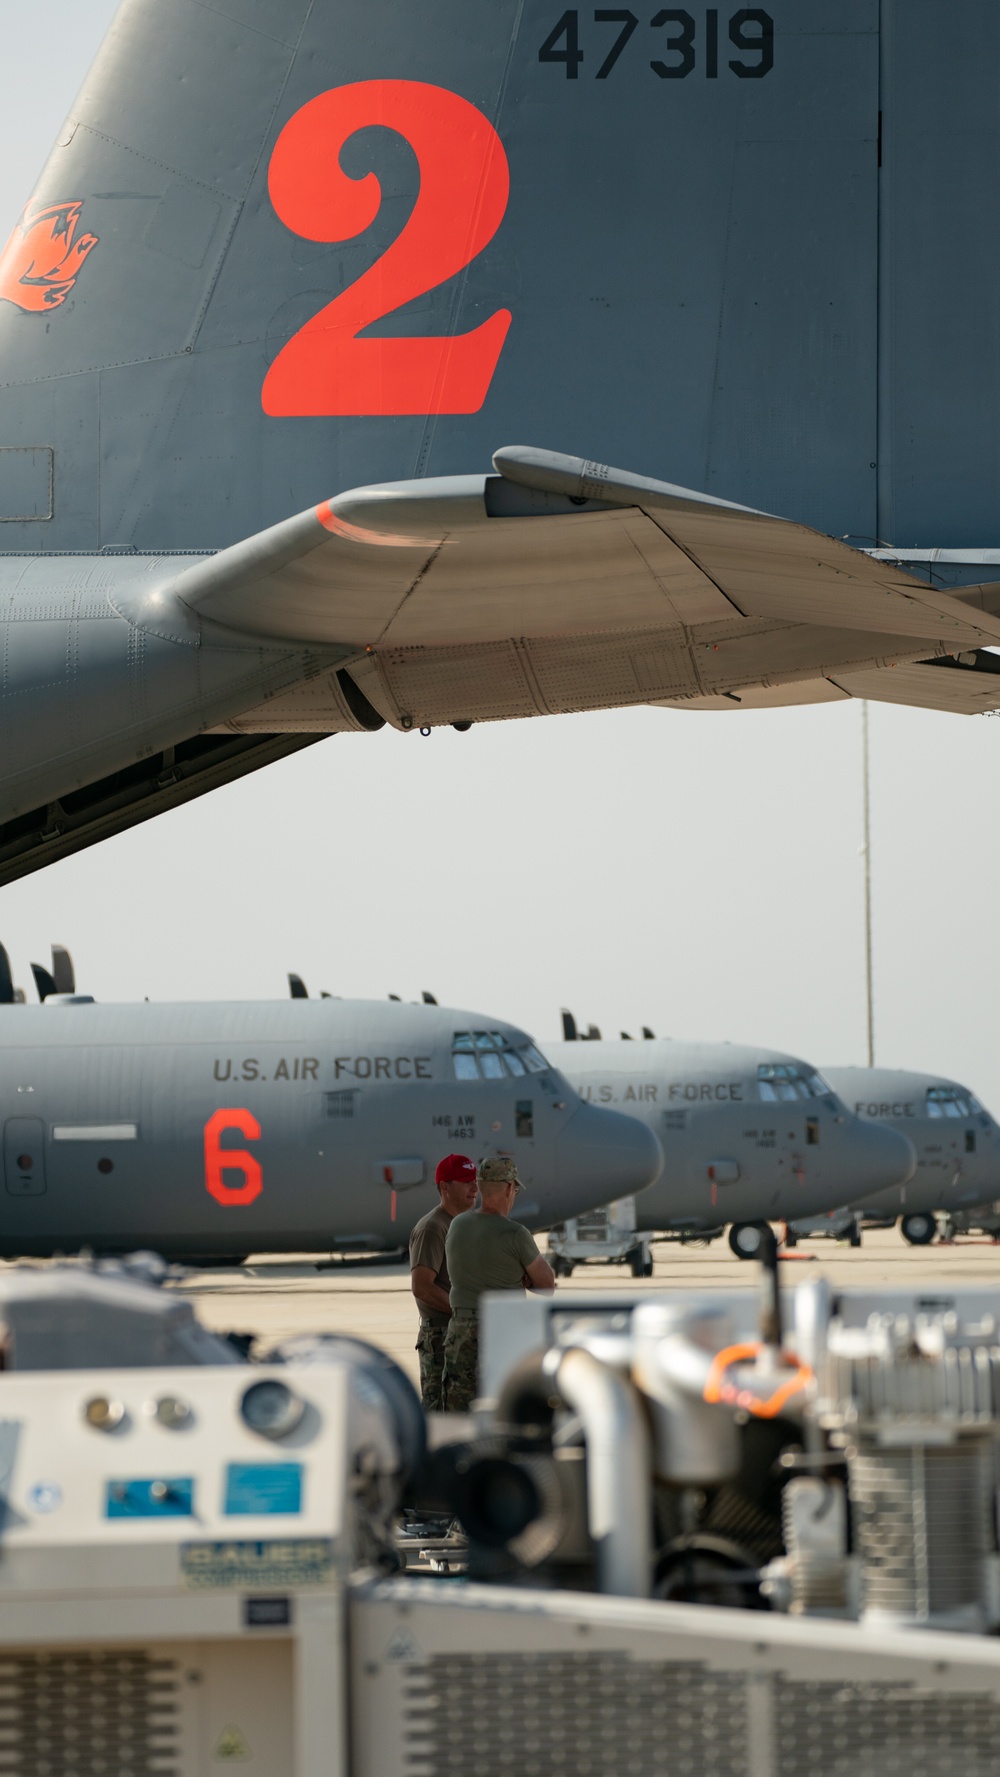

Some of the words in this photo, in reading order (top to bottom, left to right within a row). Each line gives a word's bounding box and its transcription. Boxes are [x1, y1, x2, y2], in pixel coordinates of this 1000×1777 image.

[538, 8, 774, 79] 47319
[261, 79, 512, 417] 2
[213, 1058, 267, 1082] U.S.
[273, 1057, 320, 1080] AIR
[334, 1056, 433, 1080] FORCE
[623, 1084, 658, 1102] AIR
[668, 1083, 744, 1101] FORCE
[458, 1115, 475, 1126] AW
[854, 1103, 915, 1117] FORCE
[448, 1128, 475, 1139] 1463
[204, 1108, 263, 1206] 6
